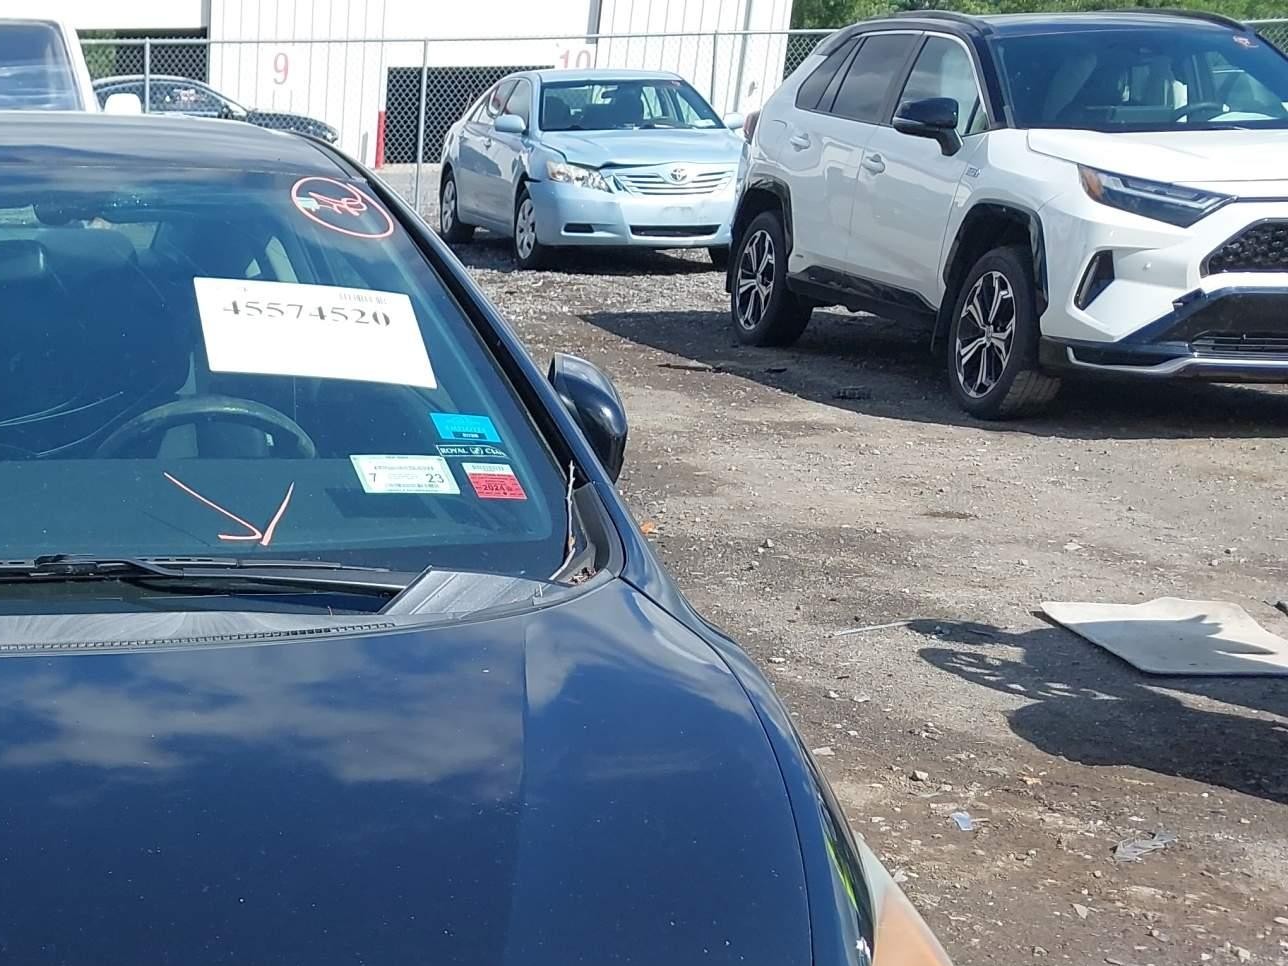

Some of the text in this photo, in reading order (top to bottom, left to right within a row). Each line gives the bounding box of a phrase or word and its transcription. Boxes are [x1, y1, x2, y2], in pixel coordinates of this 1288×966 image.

[273, 52, 289, 85] 9
[222, 299, 391, 327] 45574520
[368, 472, 445, 484] 7 23
